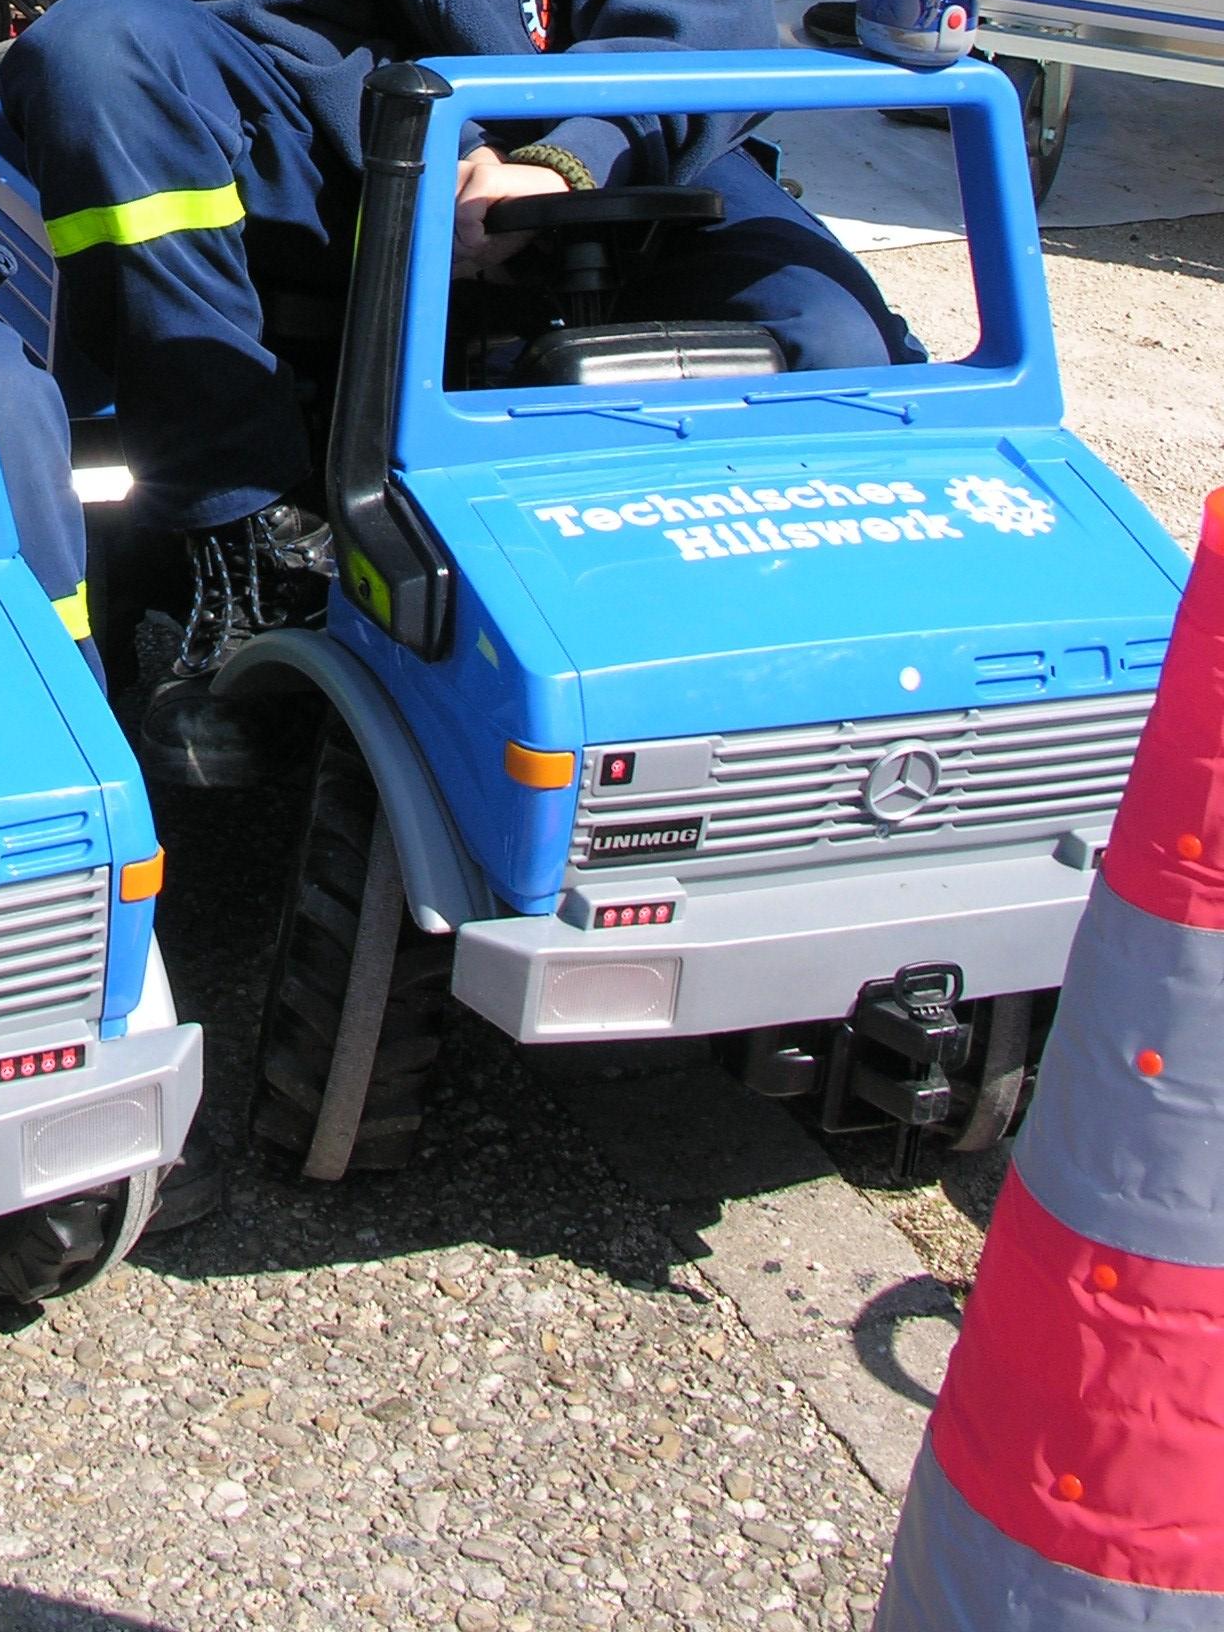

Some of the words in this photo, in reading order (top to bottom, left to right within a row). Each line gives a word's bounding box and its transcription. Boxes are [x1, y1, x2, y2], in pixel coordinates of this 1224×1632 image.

[534, 480, 926, 537] Technisches
[662, 509, 963, 561] Hilfswerk
[593, 829, 698, 850] UNIMOG
